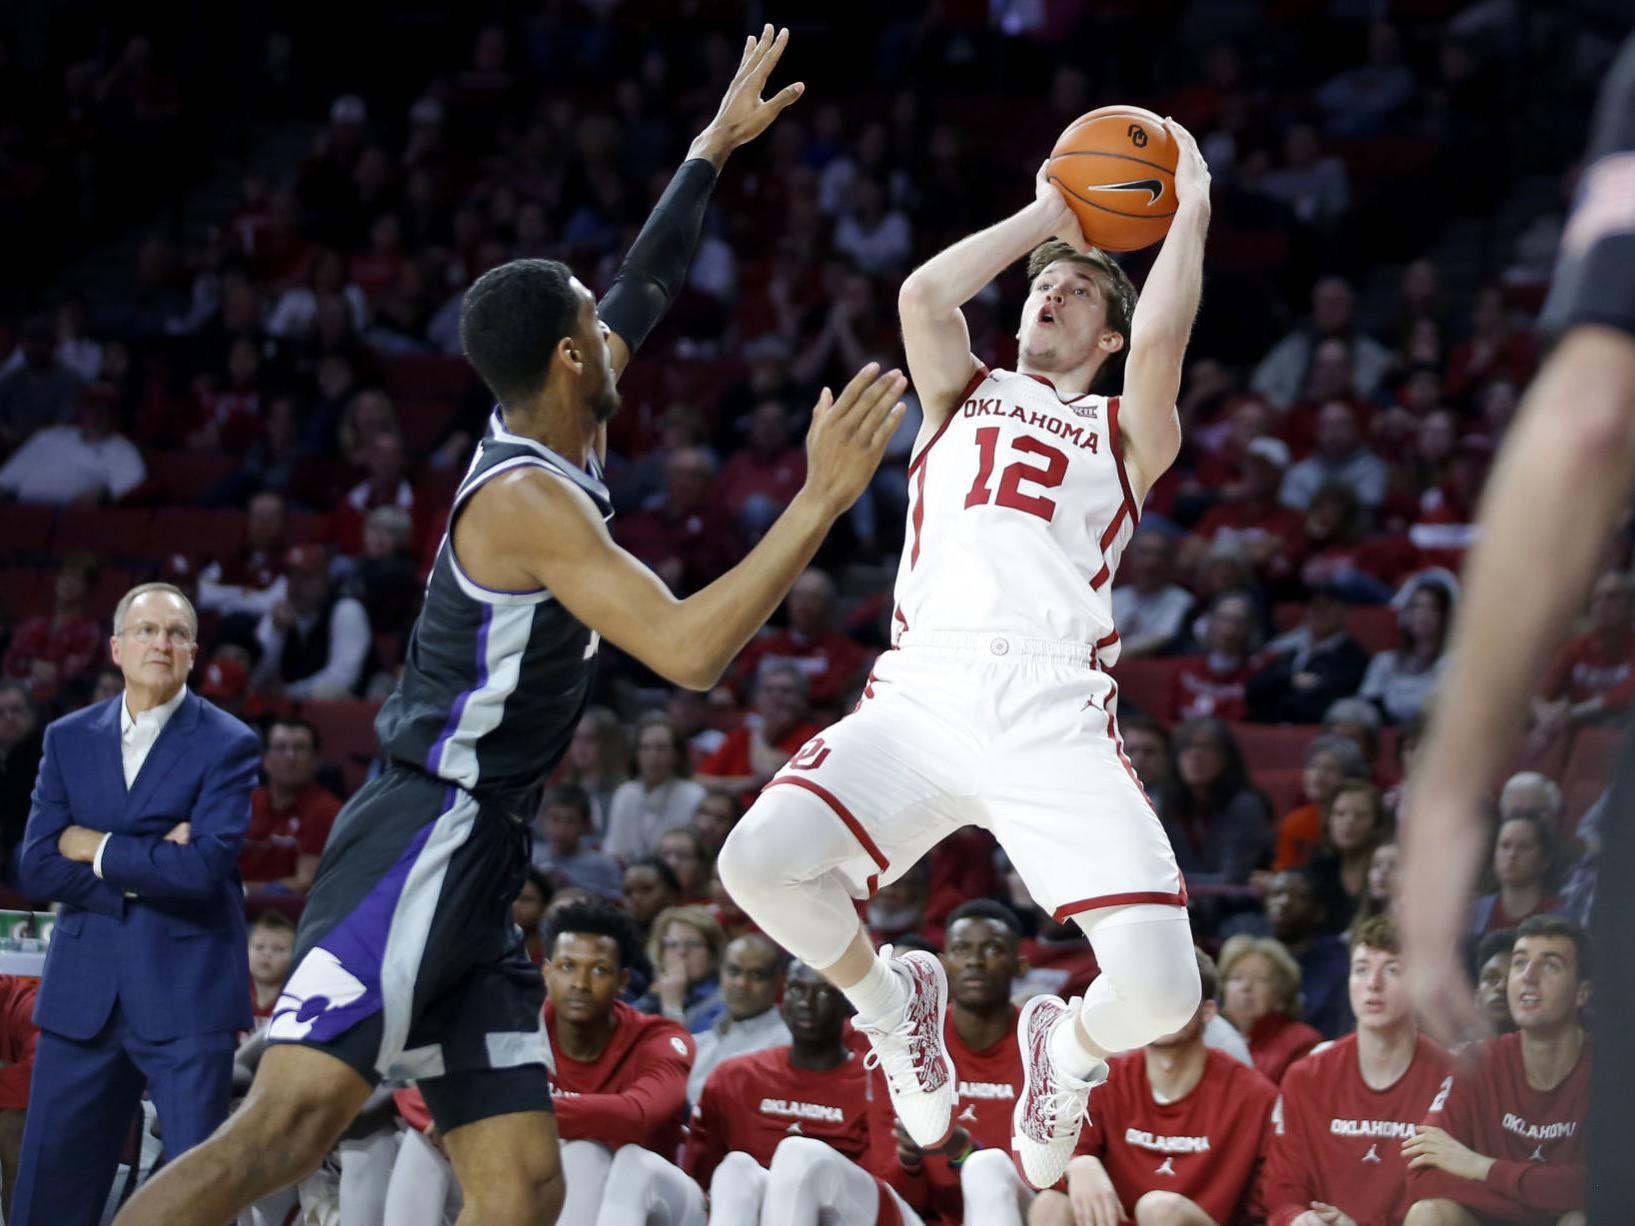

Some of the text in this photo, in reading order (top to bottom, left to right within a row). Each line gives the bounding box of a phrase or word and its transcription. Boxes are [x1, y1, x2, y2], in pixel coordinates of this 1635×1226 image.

[963, 397, 1100, 455] OKLAHOMA
[964, 426, 1070, 523] 12
[789, 738, 832, 770] OU
[959, 1081, 1015, 1099] AHOMA
[759, 1097, 845, 1123] OKLAHOMA
[1124, 1127, 1212, 1154] OKLAHOMA
[1330, 1118, 1417, 1138] OKLAHOMA
